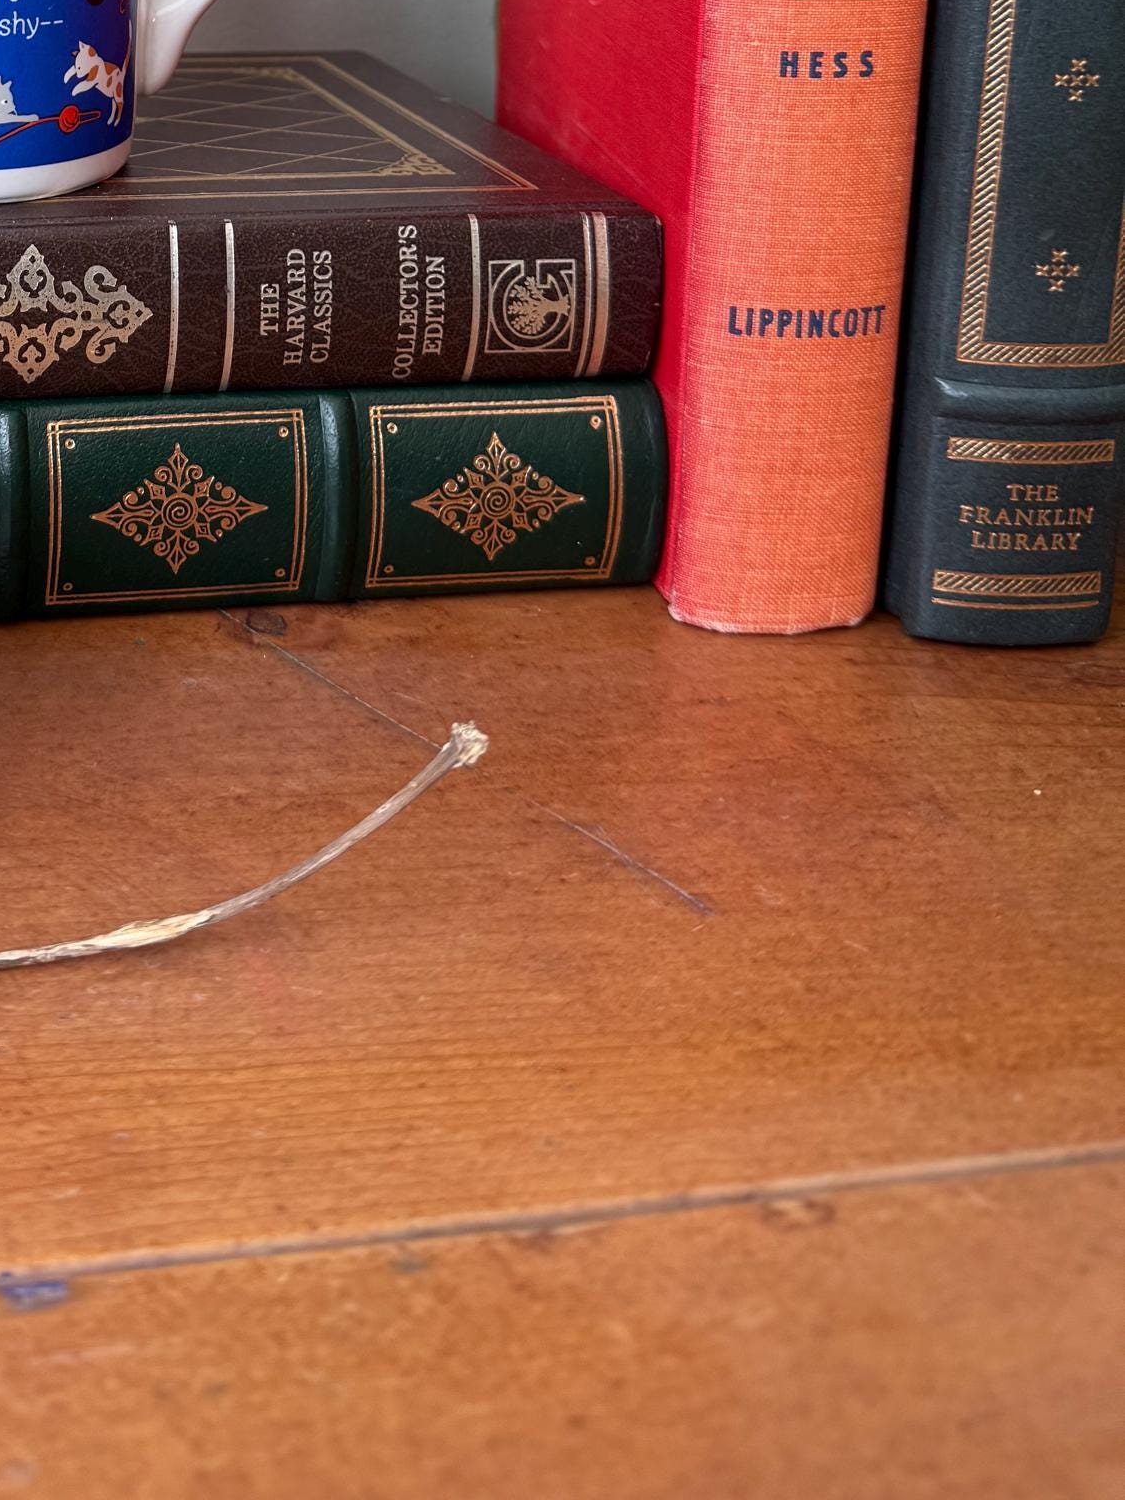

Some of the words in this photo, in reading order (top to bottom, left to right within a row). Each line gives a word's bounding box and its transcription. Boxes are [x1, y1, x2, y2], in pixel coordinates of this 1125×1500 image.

[779, 50, 874, 79] HESS
[259, 283, 280, 336] THE
[282, 248, 307, 366] HARVARD
[309, 249, 333, 363] CLASSICS
[391, 224, 420, 378] COLLECTOR'S
[421, 254, 446, 355] EDITION
[728, 304, 887, 339] LIPPINCOTT
[1005, 483, 1059, 502] THE
[958, 504, 1095, 526] FRANKLIN
[970, 529, 1081, 551] LIBRARY
